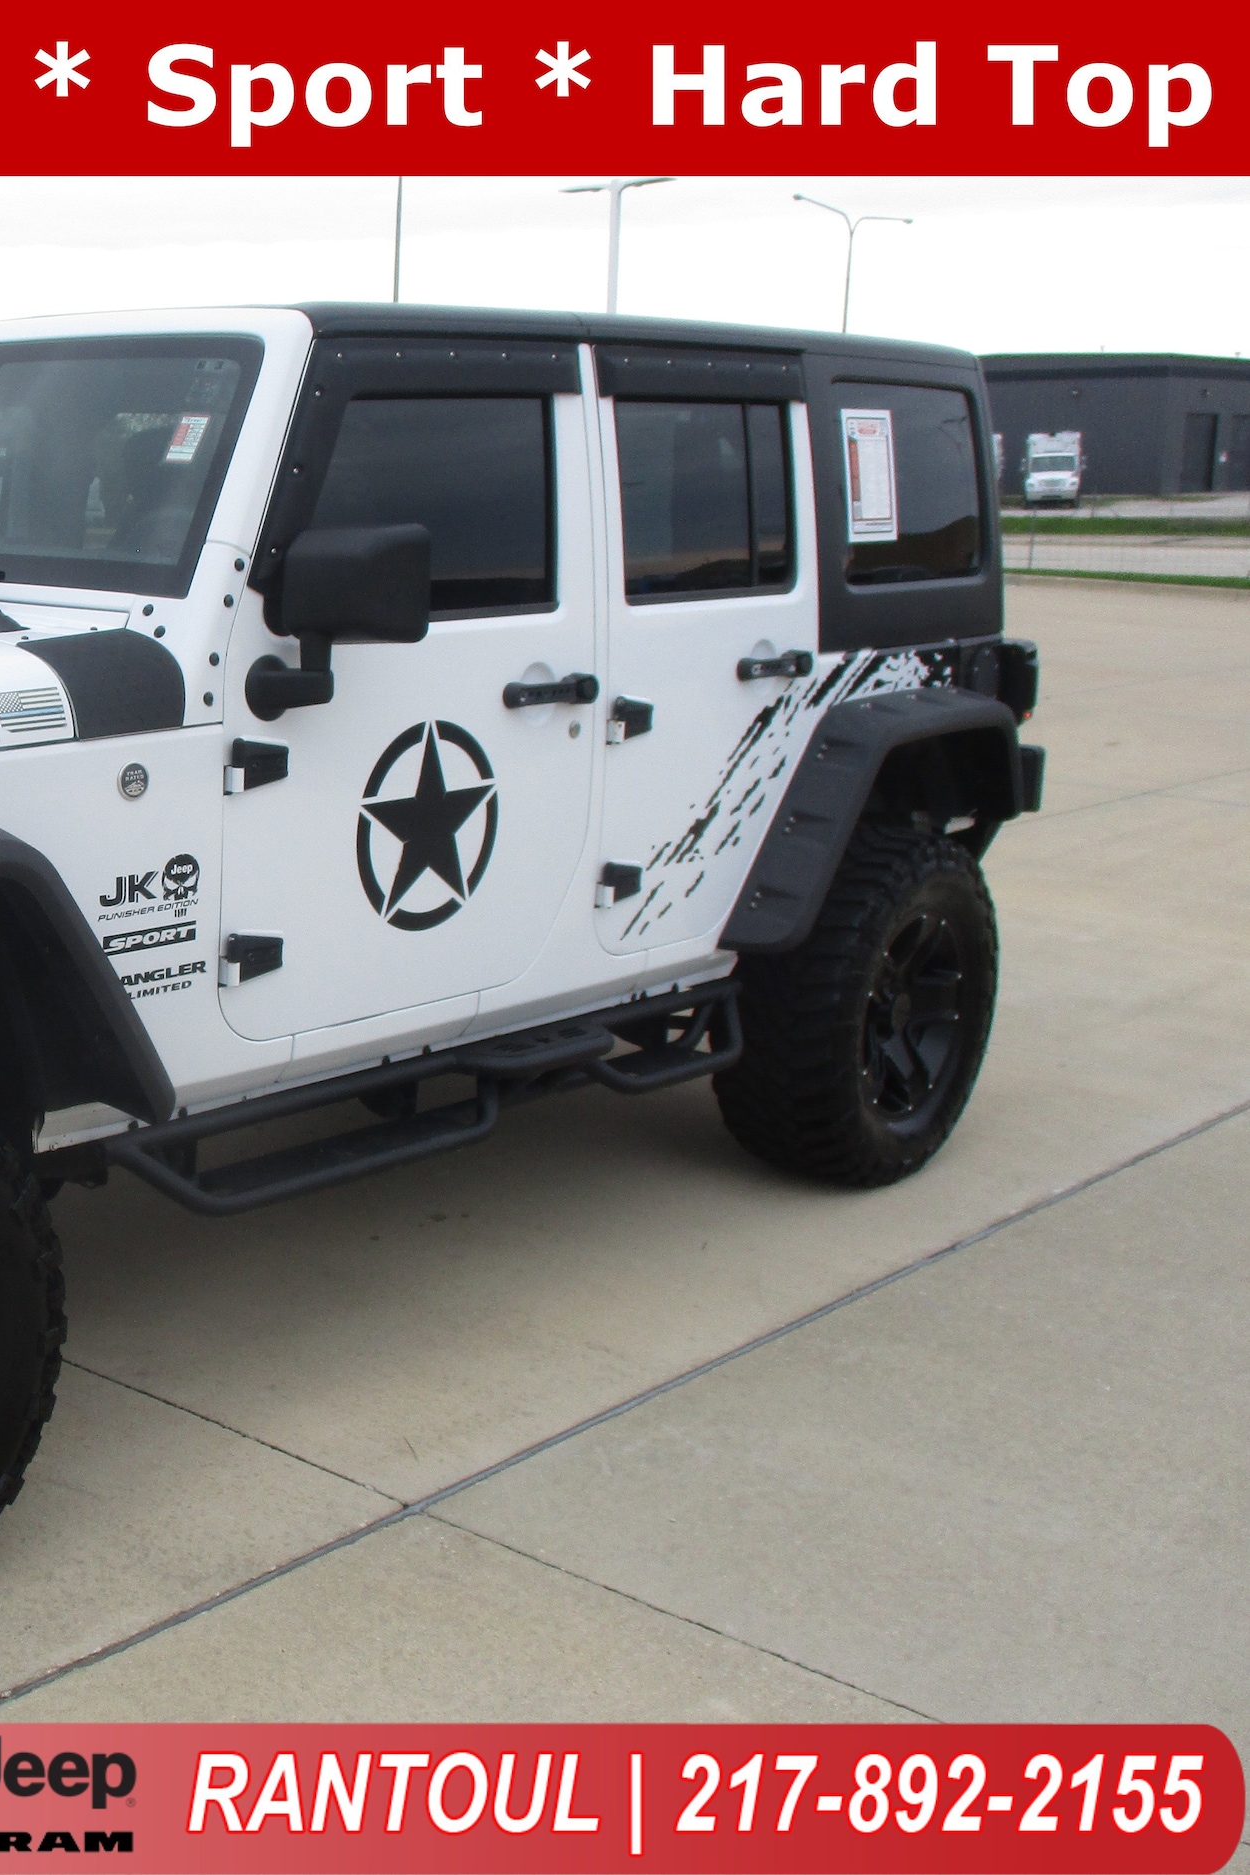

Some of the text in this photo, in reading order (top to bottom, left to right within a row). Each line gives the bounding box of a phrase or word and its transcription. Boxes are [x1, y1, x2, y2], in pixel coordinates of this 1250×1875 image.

[170, 863, 193, 875] Jeep
[99, 870, 159, 907] JK
[97, 899, 199, 922] PUNISHER EDITION
[106, 926, 196, 951] SPORT
[119, 960, 207, 986] ANGLER
[128, 980, 192, 1000] LIMITED
